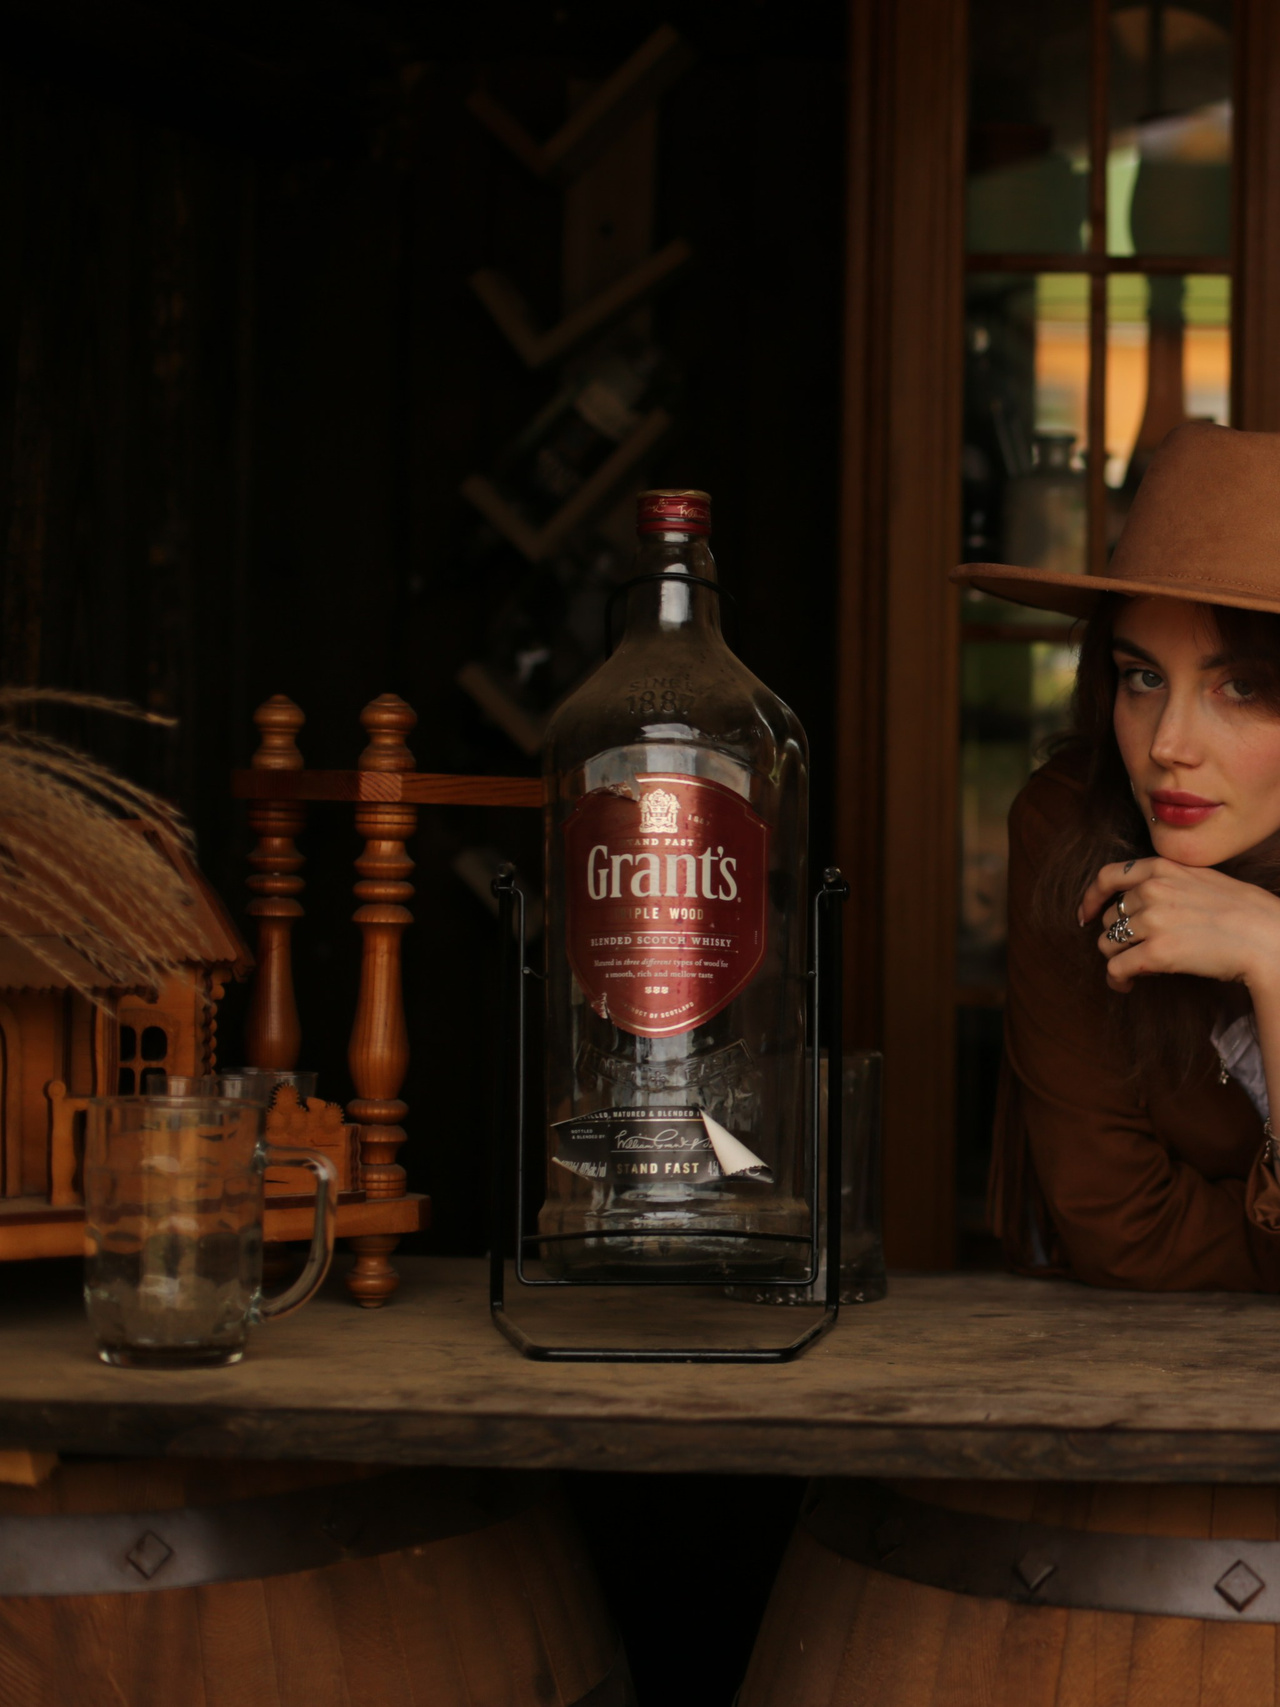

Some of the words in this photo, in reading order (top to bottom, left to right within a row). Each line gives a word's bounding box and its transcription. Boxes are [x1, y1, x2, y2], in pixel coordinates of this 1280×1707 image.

[625, 690, 695, 715] 1887
[621, 837, 659, 846] TAND
[665, 838, 694, 847] FAST
[587, 845, 738, 901] Grant's
[669, 907, 704, 920] WOOD
[590, 936, 632, 947] BLENDED
[637, 936, 686, 945] SCOTCH
[691, 937, 732, 948] WHISKY
[616, 958, 622, 966] in
[641, 957, 671, 968] different
[673, 959, 692, 968] types
[694, 958, 703, 967] of
[703, 959, 720, 968] wood
[720, 959, 728, 968] for
[610, 970, 635, 979] smooth,
[654, 970, 668, 978] and
[670, 970, 697, 978] mellow
[698, 971, 714, 979] taste
[660, 1001, 695, 1018] SCOTLAND
[612, 1110, 646, 1118] MATURED
[648, 1110, 655, 1118] &
[657, 1110, 694, 1118] BLENDED
[616, 1163, 658, 1174] STAND
[665, 1163, 700, 1174] FAST
